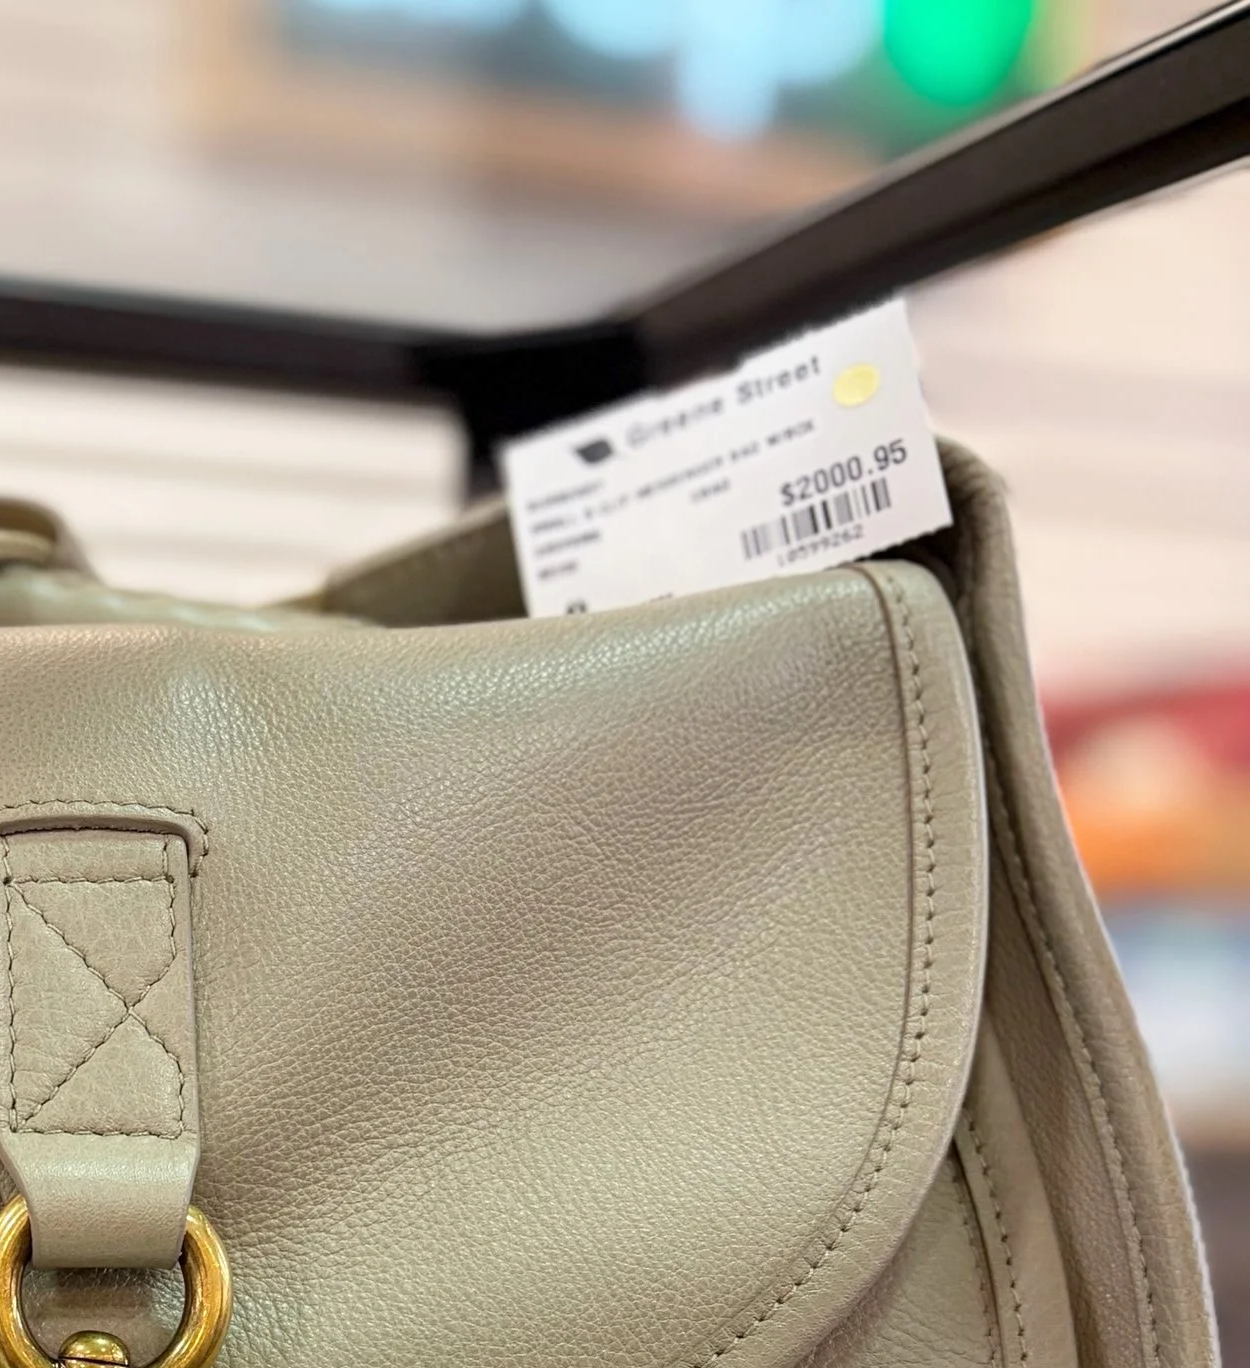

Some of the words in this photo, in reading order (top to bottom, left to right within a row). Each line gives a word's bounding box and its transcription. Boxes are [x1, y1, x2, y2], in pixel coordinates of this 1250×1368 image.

[624, 397, 725, 448] Greene
[736, 354, 821, 405] Street
[780, 438, 907, 507] $2000.95
